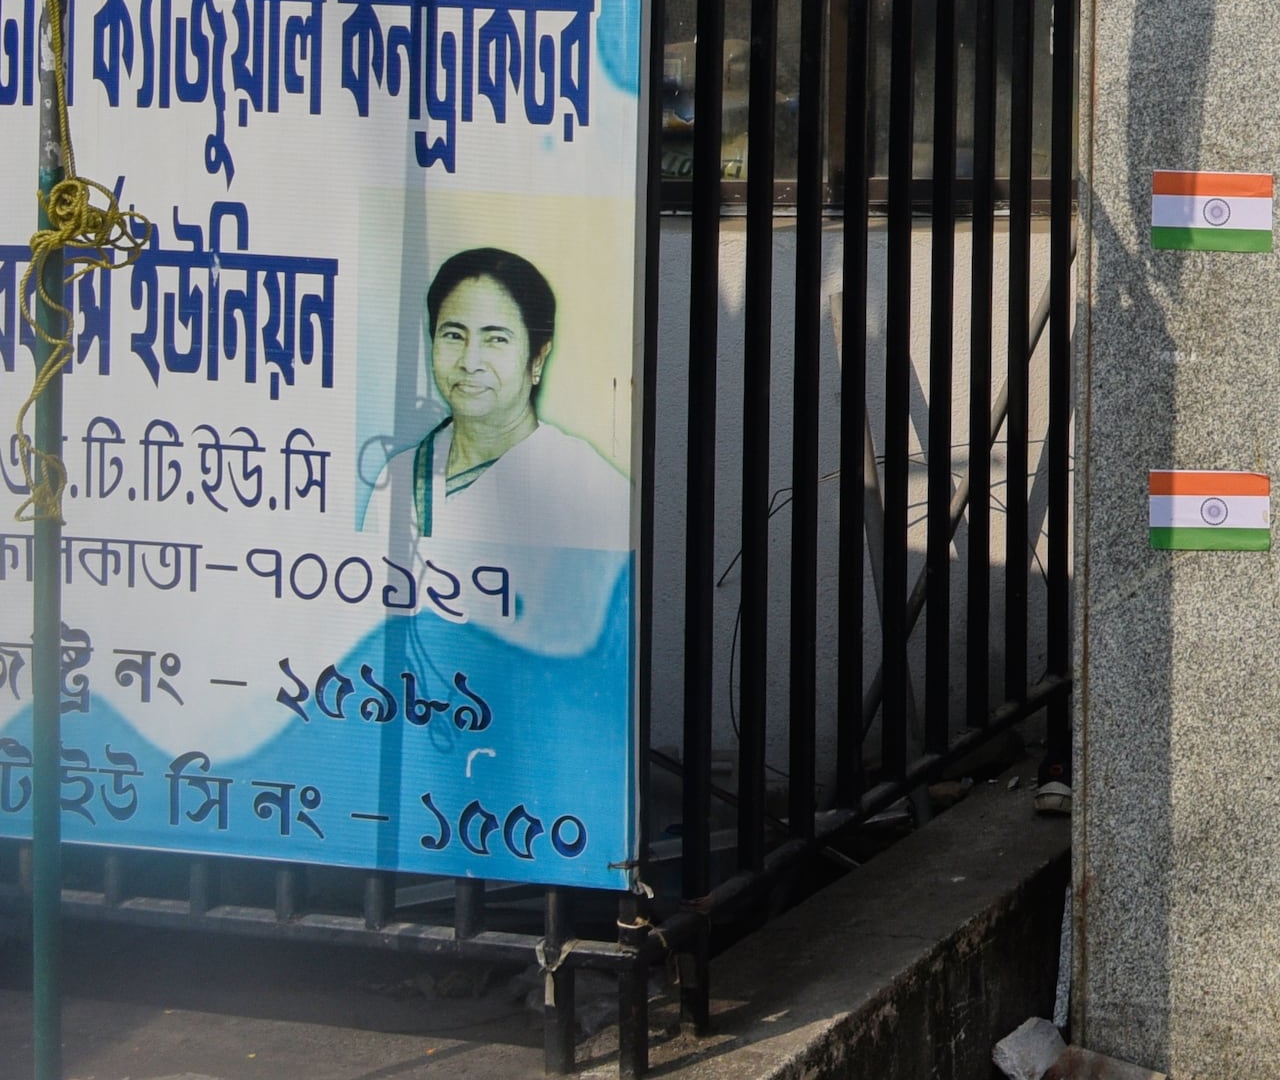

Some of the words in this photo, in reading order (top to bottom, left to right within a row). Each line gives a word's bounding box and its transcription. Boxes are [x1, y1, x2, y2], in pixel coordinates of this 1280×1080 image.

[112, 648, 185, 706] নং
[251, 779, 325, 841] নং
[419, 792, 588, 859] ১৫৫০
